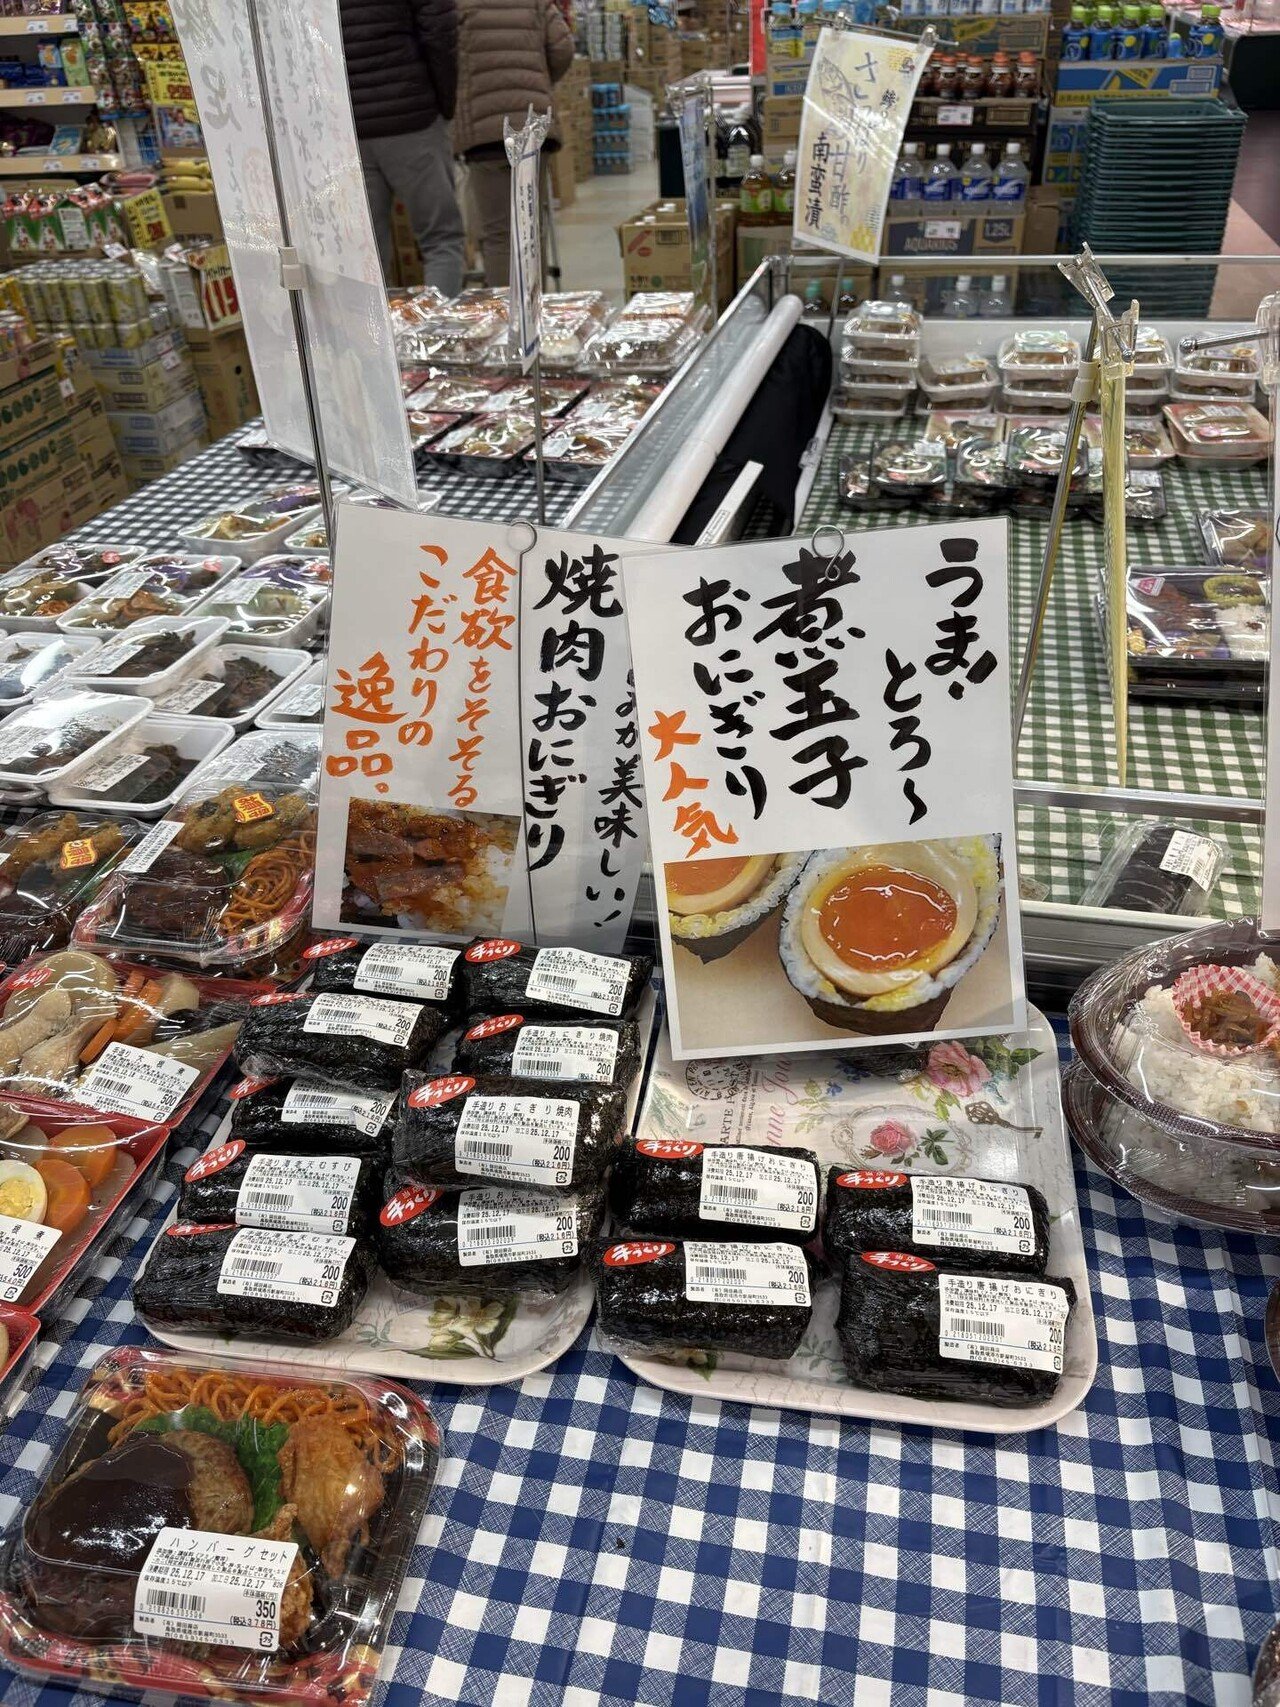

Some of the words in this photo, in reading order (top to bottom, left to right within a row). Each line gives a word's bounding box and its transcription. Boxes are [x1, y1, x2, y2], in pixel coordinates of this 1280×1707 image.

[397, 545, 458, 747] こだわりの
[447, 547, 519, 808] 食欲をそそる
[753, 547, 869, 810] 煮玉子
[682, 576, 767, 820] おにぎり
[523, 544, 623, 872] 焼肉おにぎり
[648, 710, 739, 858] 大人気
[432, 969, 448, 980] 200
[607, 983, 623, 995] 200
[394, 1018, 412, 1030] 200
[596, 1063, 611, 1075] 200
[159, 1093, 178, 1107] 500
[368, 1101, 388, 1115] 200
[471, 1100, 573, 1117] 手造りおにぎり焼肉
[720, 1108, 735, 1144] ARTE
[552, 1145, 571, 1160] 200
[711, 1149, 806, 1170] 手造り唐揚げおにぎり
[919, 1177, 1018, 1196] 手造り唐揚げおにぎり
[330, 1195, 348, 1210] 200
[797, 1190, 813, 1205] 200
[556, 1216, 572, 1230] 200
[1013, 1216, 1030, 1230] 200
[13, 1263, 34, 1280] 500
[320, 1264, 341, 1280] 200
[788, 1270, 804, 1284] 200
[948, 1278, 1057, 1299] 手造り唐揚げおにぎり
[966, 1301, 997, 1312] 25.12.17
[1021, 1308, 1052, 1318] 25.12.17
[1049, 1327, 1062, 1344] 200
[169, 1534, 288, 1564] ハンバーグセット
[169, 1567, 205, 1581] 25.12.17
[228, 1576, 265, 1589] 25.12.17
[253, 1599, 277, 1619] 350
[228, 1615, 277, 1630] (税込378円)
